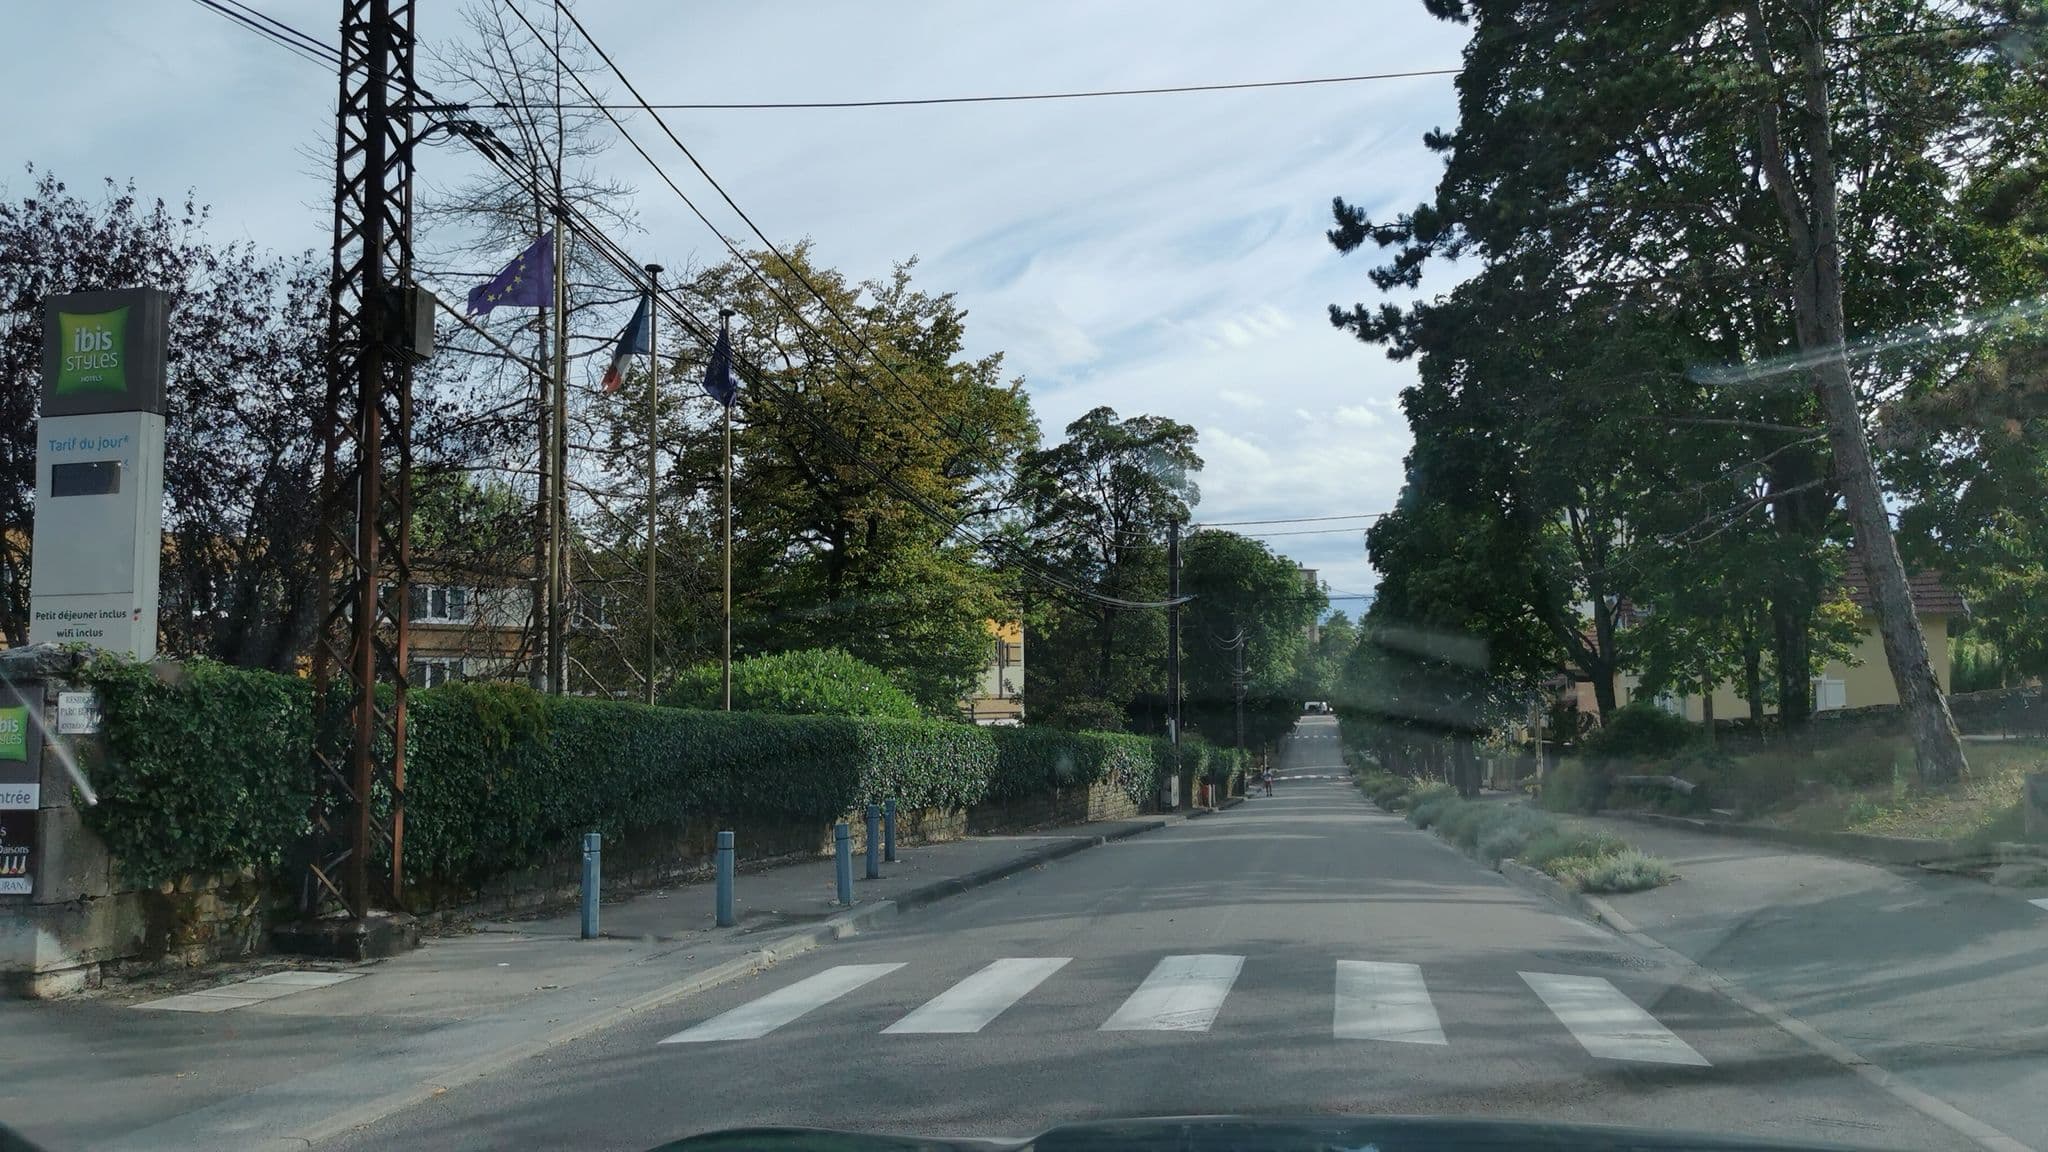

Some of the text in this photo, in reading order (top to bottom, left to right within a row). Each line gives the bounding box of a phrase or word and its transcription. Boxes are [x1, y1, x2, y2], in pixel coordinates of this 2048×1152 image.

[74, 325, 113, 352] ibis
[49, 439, 75, 451] Tarif
[80, 438, 94, 449] du
[36, 609, 127, 621] Petit déjeuner inclus
[57, 628, 103, 638] wifi inclus
